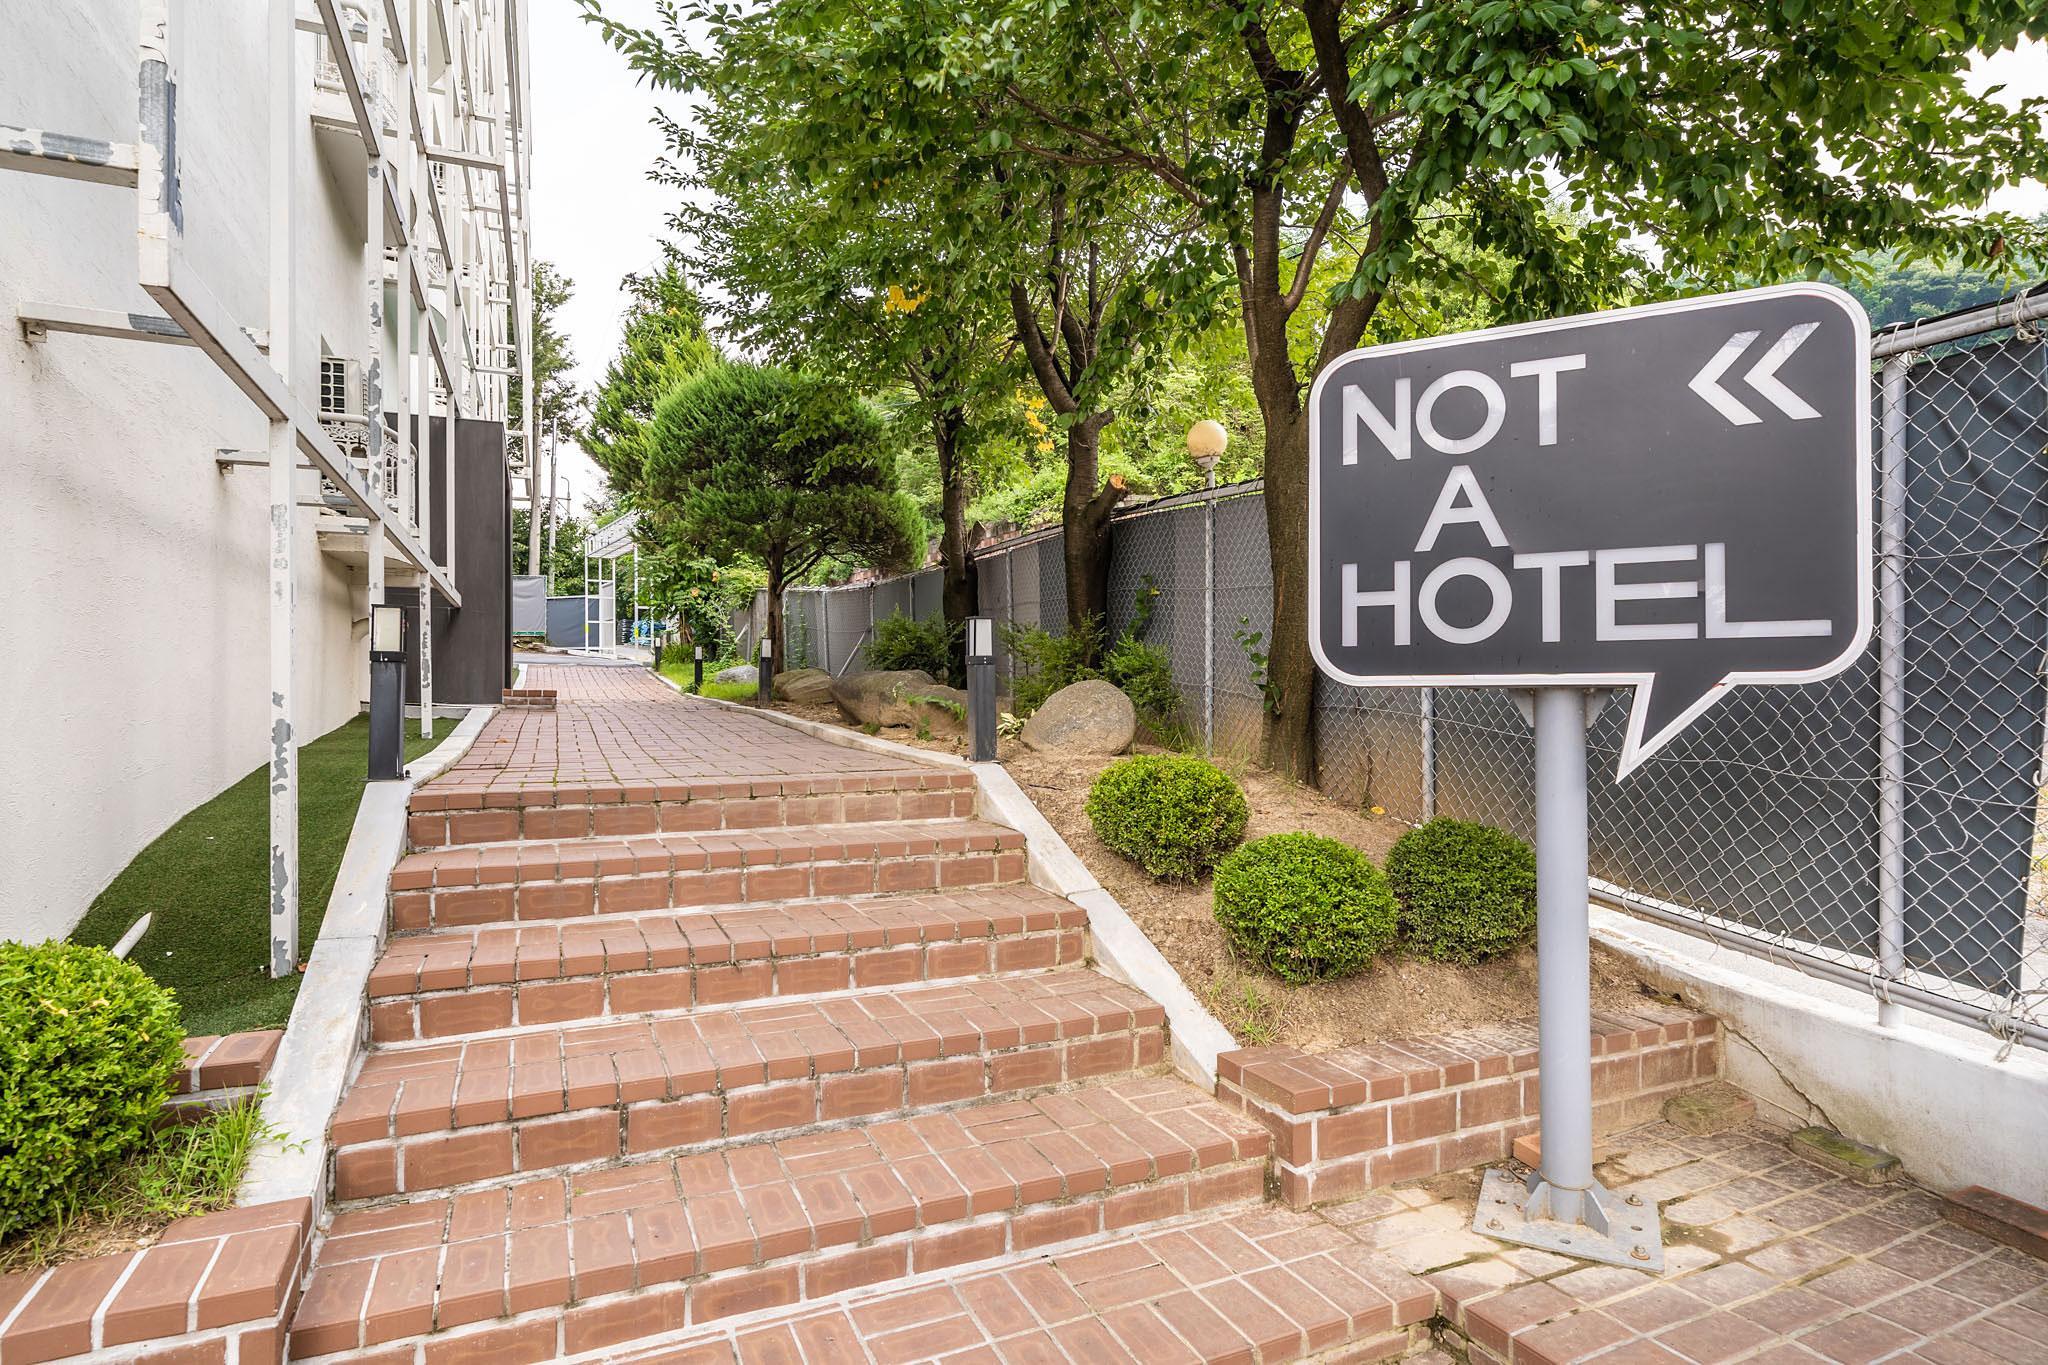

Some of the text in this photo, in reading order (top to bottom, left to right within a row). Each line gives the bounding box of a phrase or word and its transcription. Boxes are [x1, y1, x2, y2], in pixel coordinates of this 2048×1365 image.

[1342, 353, 1587, 466] NOT
[1414, 464, 1510, 553] A
[1341, 542, 1832, 647] HOTEL
